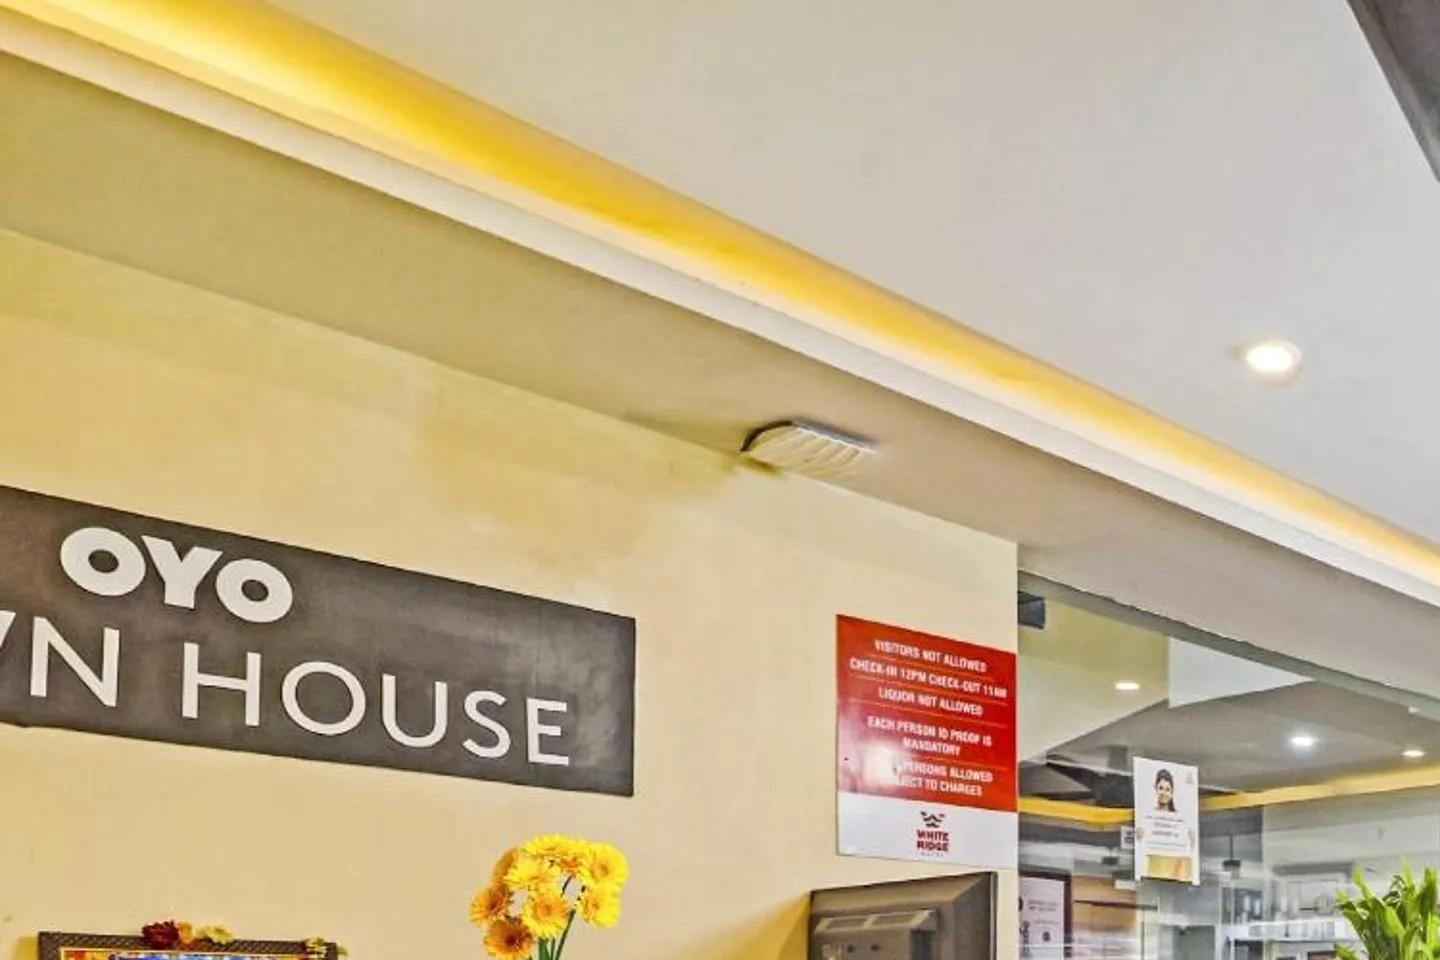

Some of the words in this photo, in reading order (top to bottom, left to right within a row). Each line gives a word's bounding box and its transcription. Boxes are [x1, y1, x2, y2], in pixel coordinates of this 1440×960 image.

[60, 526, 293, 623] OYO
[874, 640, 920, 659] VISITORS
[922, 650, 941, 663] NOT
[943, 654, 987, 673] ALLOWED
[850, 657, 898, 677] CHECK-IN
[929, 673, 982, 693] CHECK-OUT
[181, 642, 570, 766] HOUSE
[879, 687, 915, 703] LIQUOR
[917, 694, 937, 707] NOT
[939, 698, 983, 717] ALLOWED
[867, 716, 895, 731] EACH
[897, 721, 936, 737] PERSON
[938, 727, 949, 740] ID
[903, 737, 960, 756] MANDATORY
[950, 767, 993, 783] ALLOWED
[925, 779, 938, 791] TO
[940, 780, 982, 797] CHARGES
[916, 829, 949, 841] WHITE
[917, 841, 949, 851] RIDGE
